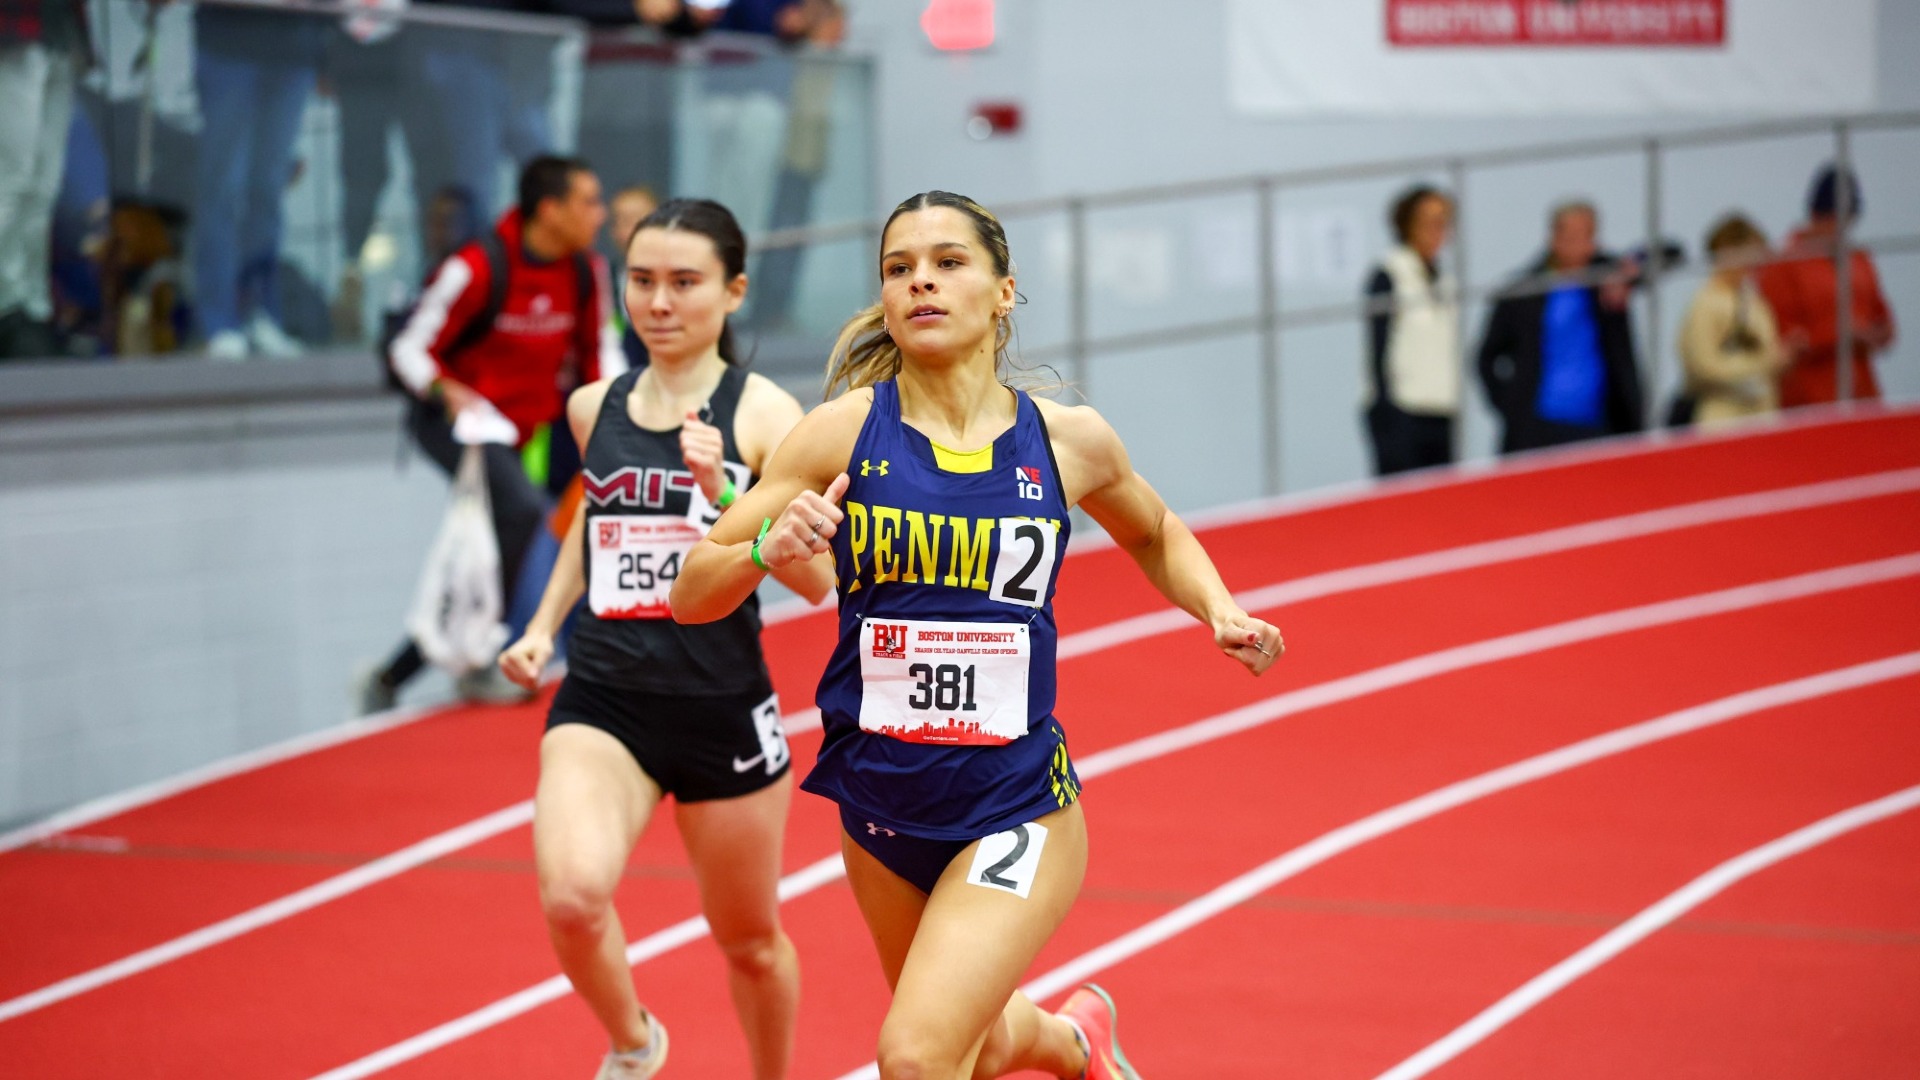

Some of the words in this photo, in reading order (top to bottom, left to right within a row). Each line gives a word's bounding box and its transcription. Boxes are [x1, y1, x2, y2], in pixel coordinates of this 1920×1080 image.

[1018, 482, 1043, 501] 10
[846, 500, 1061, 594] PENM
[1002, 524, 1045, 602] 2
[618, 551, 680, 590] 254
[872, 624, 908, 653] BU
[917, 631, 954, 642] BOSTON
[956, 632, 1016, 643] UNIVERSITY
[908, 662, 977, 711] 381
[980, 824, 1030, 890] 2
